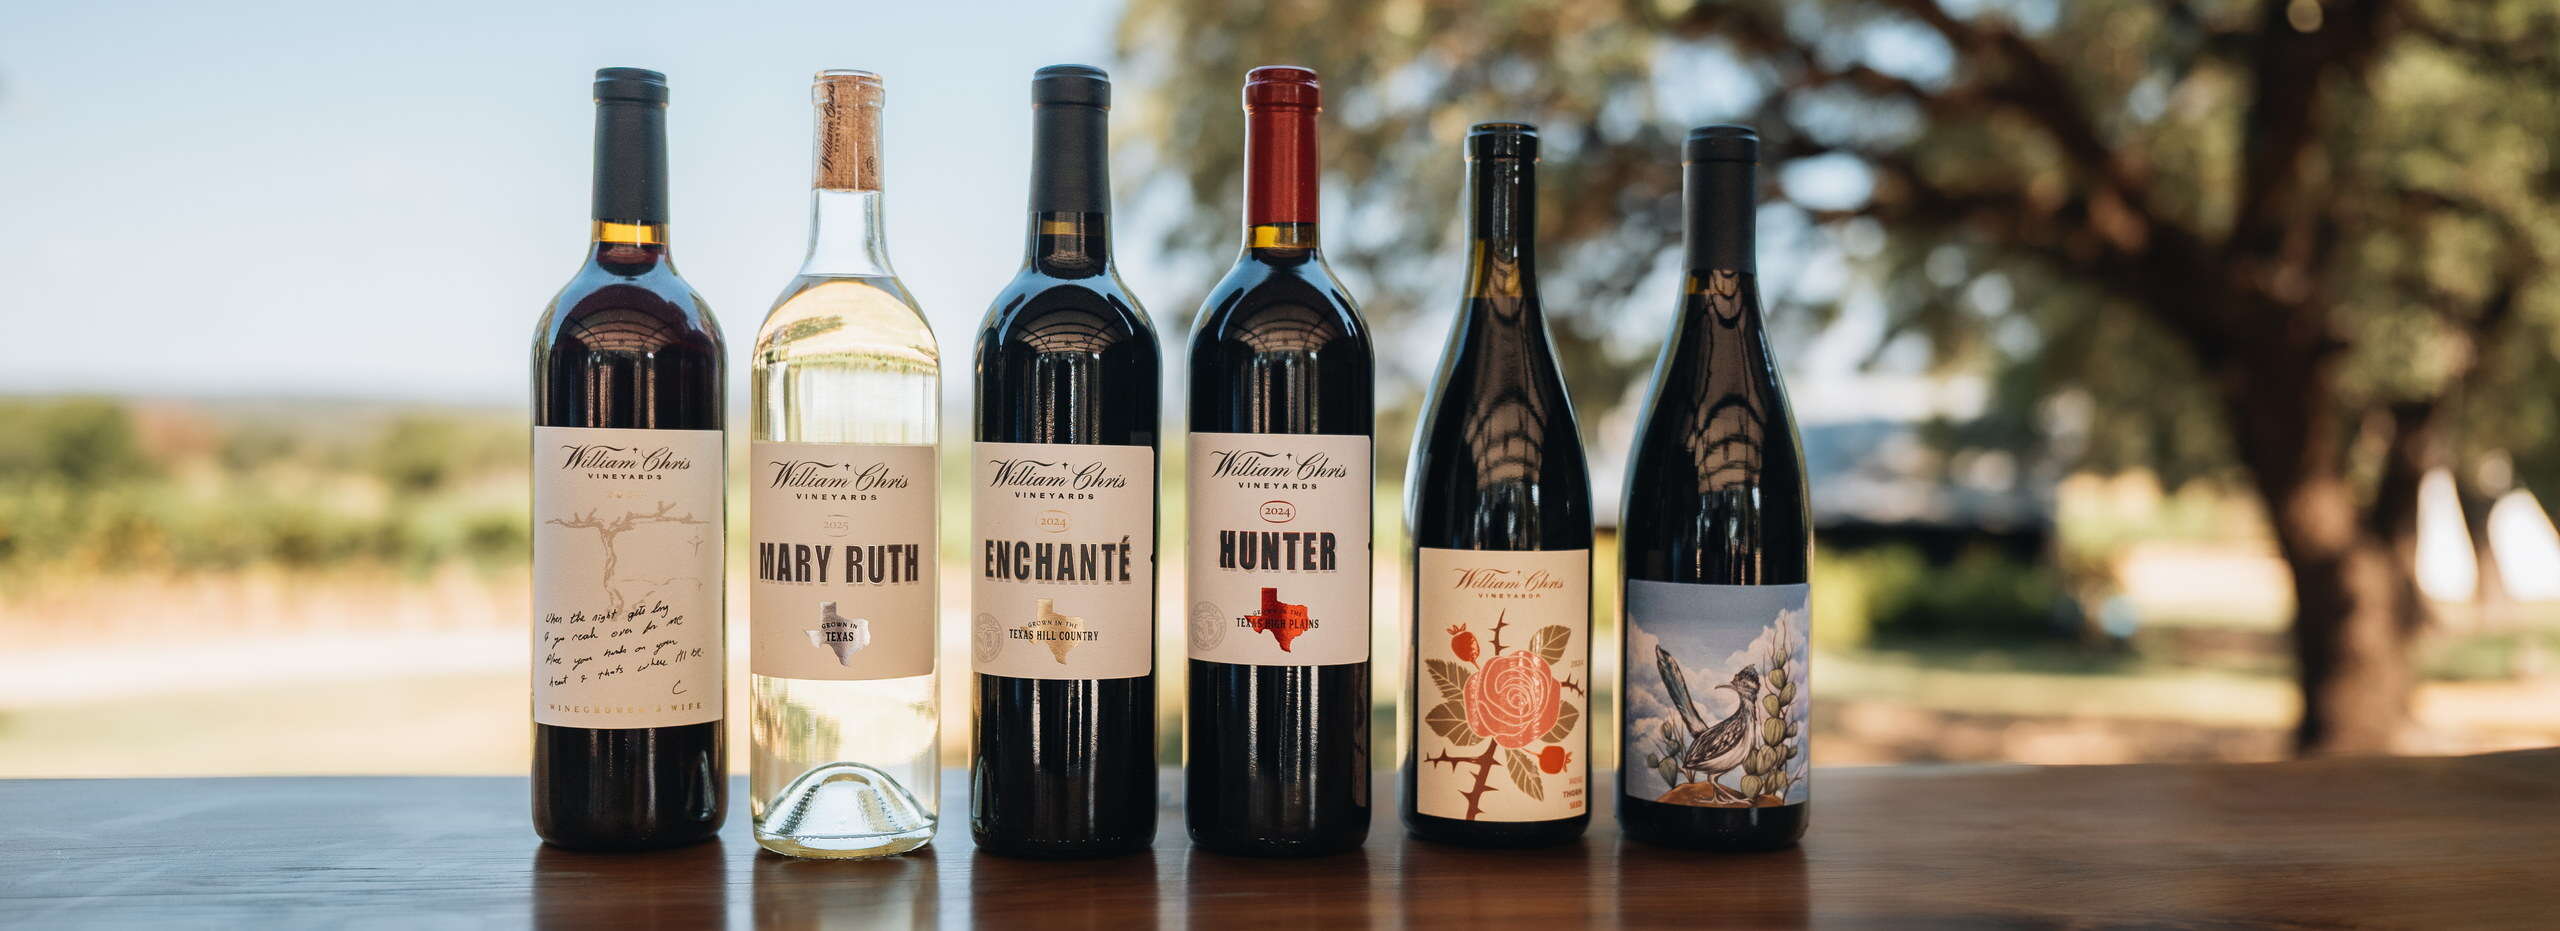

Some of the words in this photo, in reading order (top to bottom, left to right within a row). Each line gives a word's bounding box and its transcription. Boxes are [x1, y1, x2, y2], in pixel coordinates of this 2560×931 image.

[820, 120, 834, 174] William
[560, 444, 638, 470] William
[641, 447, 691, 472] Chris
[1210, 449, 1291, 479] William
[1296, 451, 1348, 481] Chris
[769, 460, 849, 489] William
[854, 462, 910, 492] Chris
[988, 459, 1067, 488] William
[1072, 461, 1128, 491] Chris
[1238, 482, 1318, 490] VINEYARDS
[796, 493, 878, 501] VINEYARDS
[1015, 491, 1095, 500] VINEYARDS
[1265, 507, 1291, 519] 2024
[1041, 517, 1066, 528] 2024
[1219, 530, 1337, 572] HUNTER
[759, 542, 832, 583] MARY
[846, 544, 919, 584] RUTH
[985, 535, 1131, 583] ENCHANTÉ
[1452, 568, 1520, 589] William
[1524, 569, 1564, 592] Chris
[570, 610, 585, 624] the
[592, 609, 617, 623] night
[1236, 617, 1263, 629] TEXAS
[1289, 618, 1320, 629] PLAINS
[821, 621, 848, 629] GROWN
[1066, 621, 1079, 629] THE
[611, 628, 632, 638] over
[826, 631, 854, 641] TEXAS
[1009, 628, 1034, 640] TEXAS
[1036, 630, 1056, 640] HILL
[1059, 631, 1099, 641] COUNTRY
[550, 702, 661, 714] WINEGROWES
[671, 701, 703, 711] WIFE
